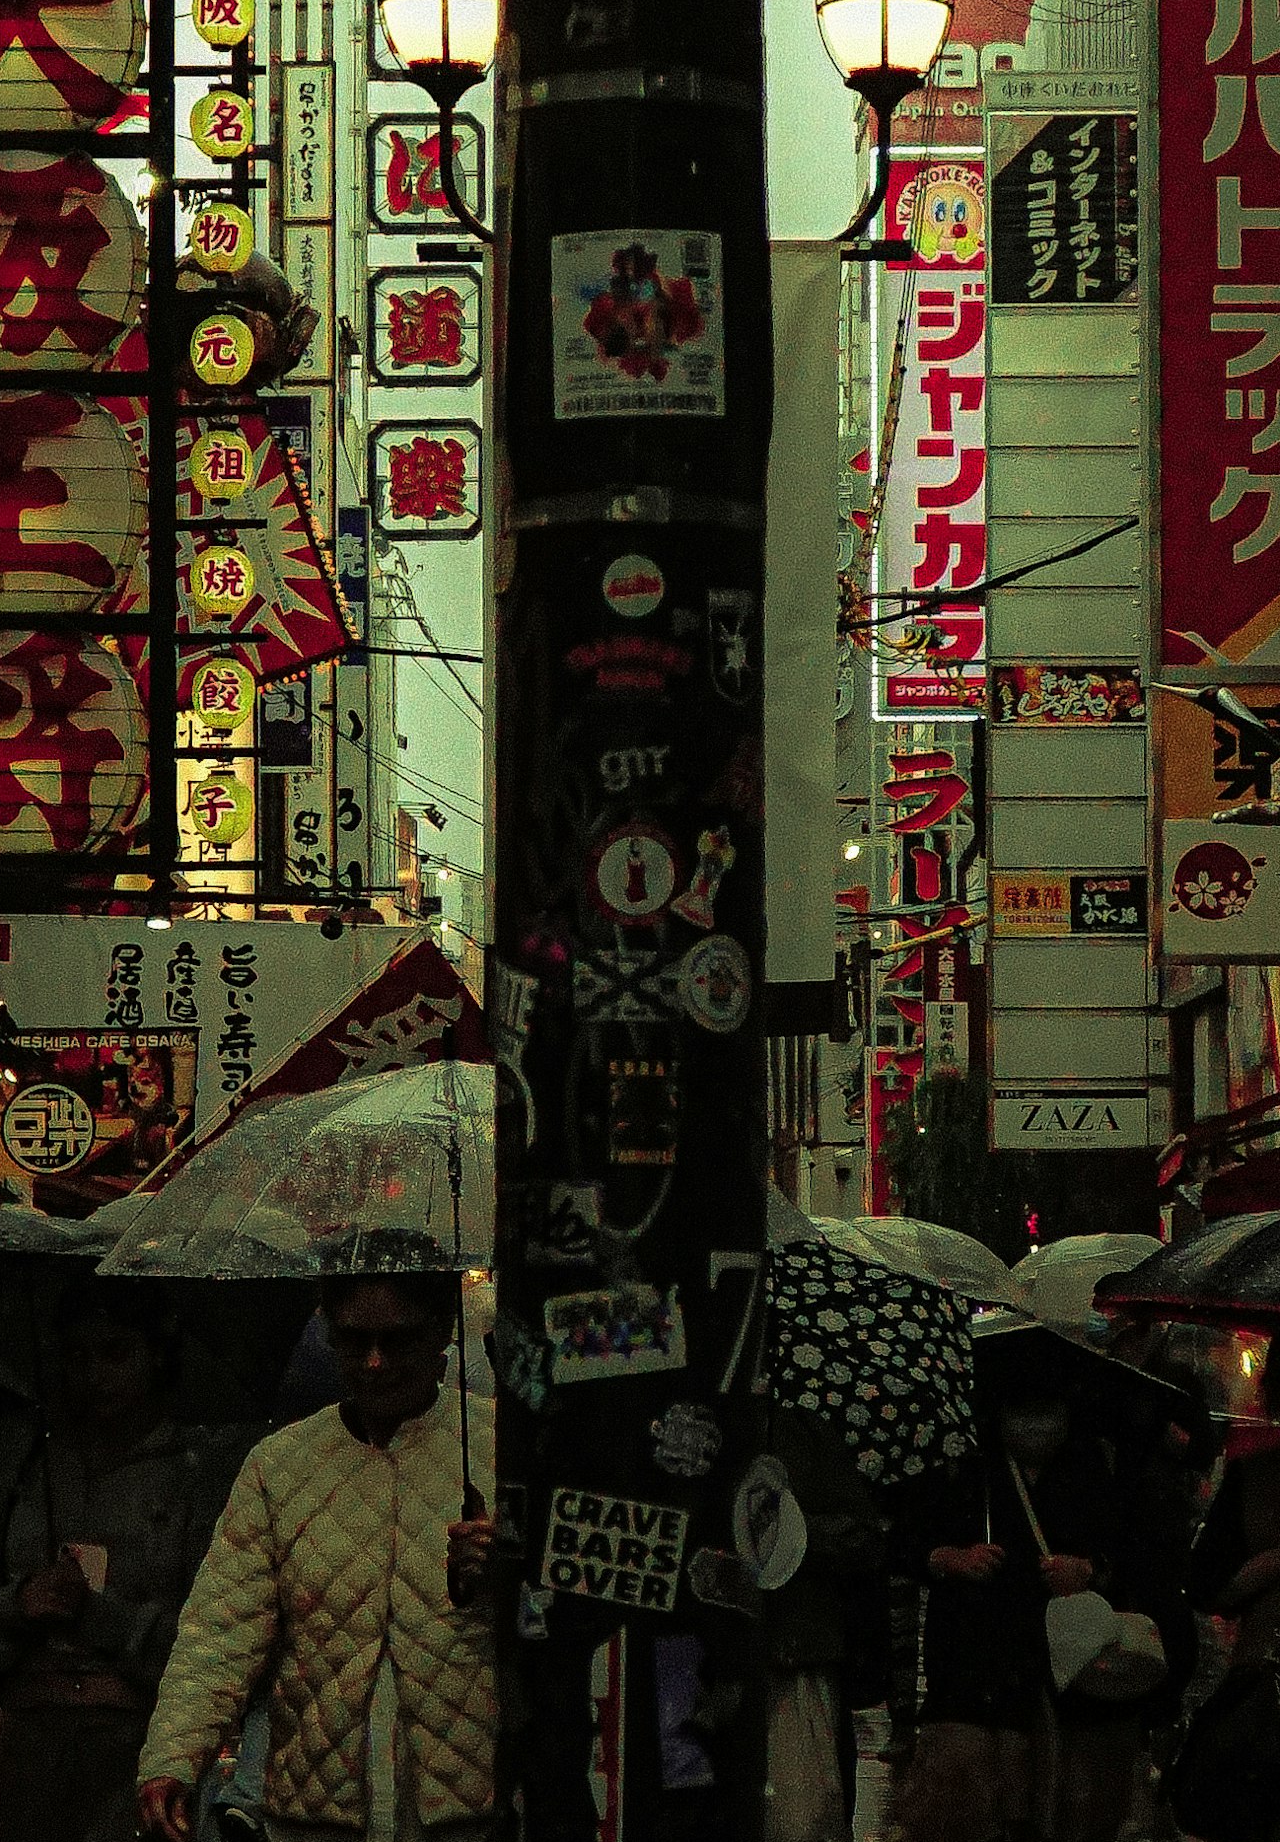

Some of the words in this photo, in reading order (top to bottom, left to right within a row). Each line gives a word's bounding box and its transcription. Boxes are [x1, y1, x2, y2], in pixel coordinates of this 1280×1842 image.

[1026, 148, 1060, 300] &コミック
[1068, 117, 1102, 299] インターネット
[85, 1034, 132, 1049] CAFE
[218, 944, 258, 1105] 旨い寿司
[1020, 1104, 1122, 1132] ZAZA
[554, 1489, 684, 1541] CRAVE
[552, 1523, 680, 1575] BARS
[548, 1557, 672, 1613] OVER
